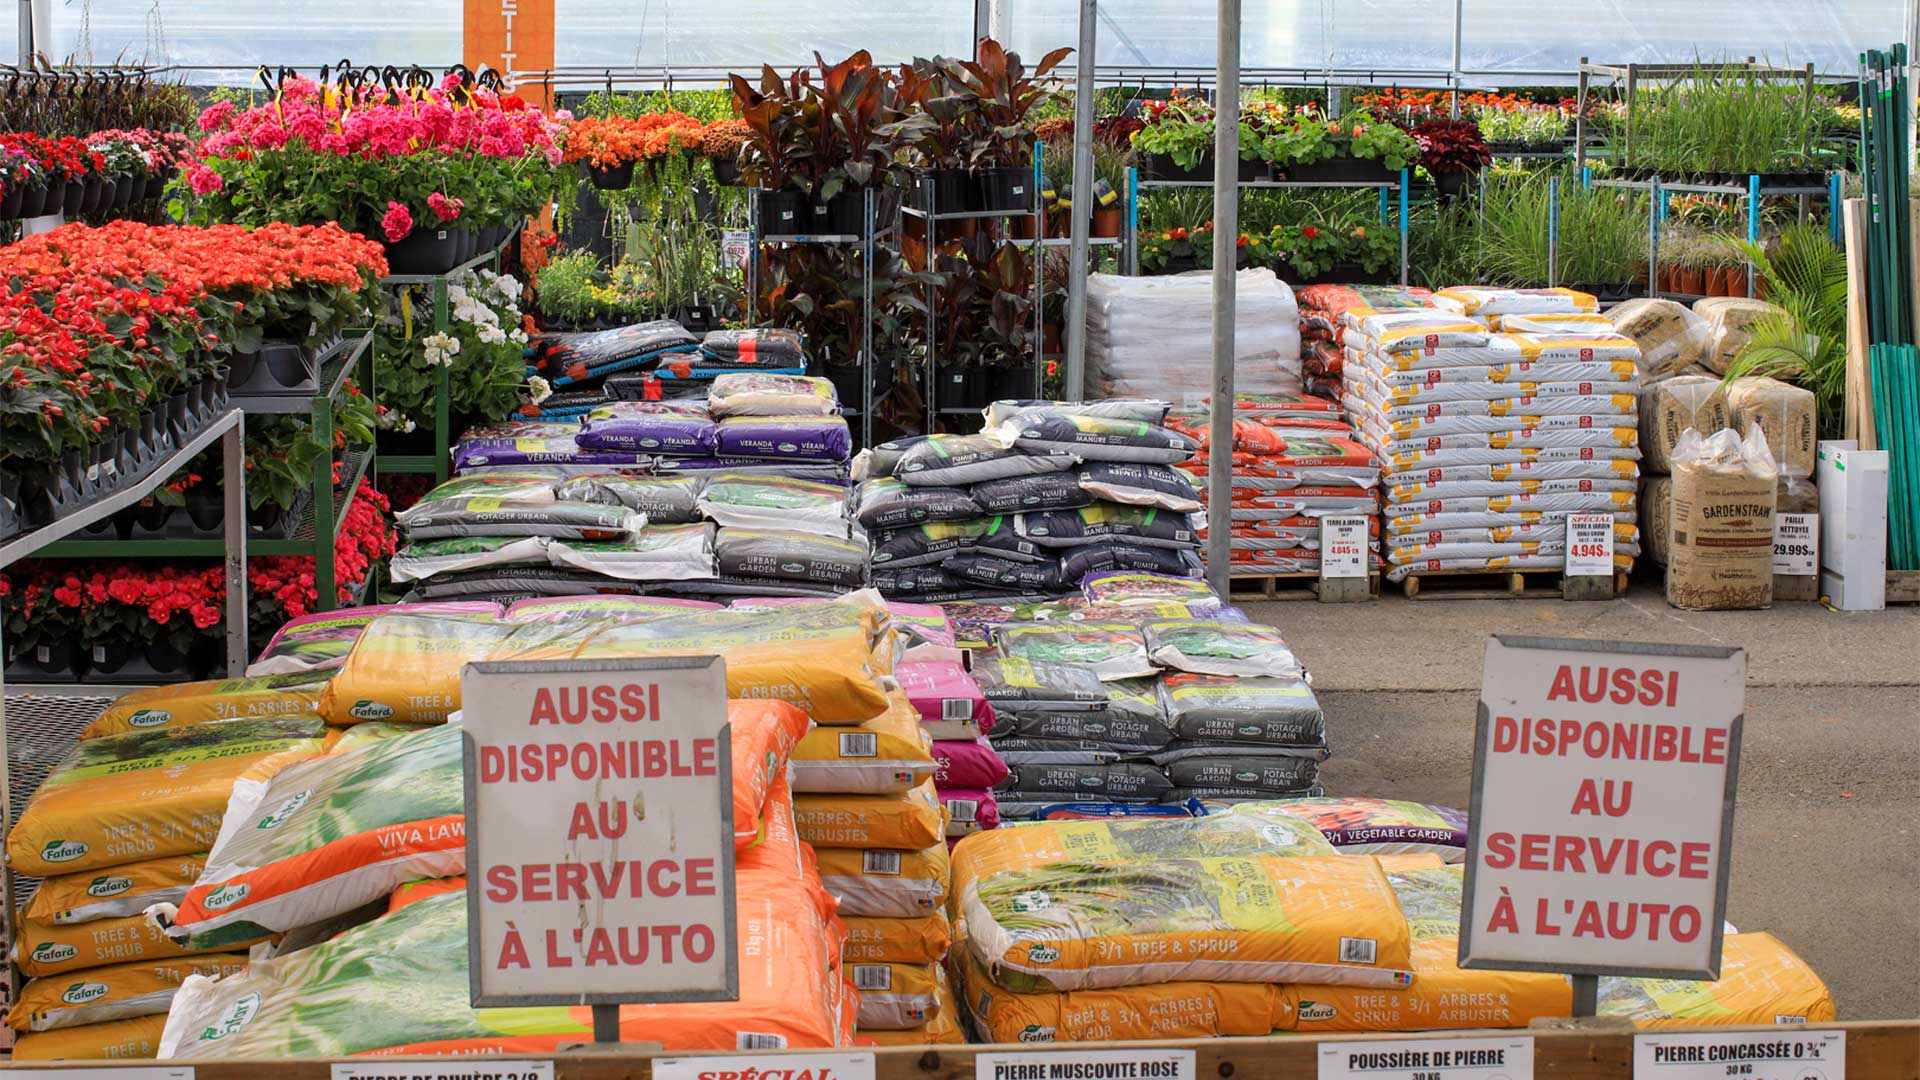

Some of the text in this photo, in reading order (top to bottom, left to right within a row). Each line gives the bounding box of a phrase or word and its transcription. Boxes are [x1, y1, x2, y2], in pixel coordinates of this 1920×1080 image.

[801, 442, 826, 450] VÉRAN
[637, 502, 674, 511] POTAGER
[1703, 504, 1771, 519] GARDENSTRAW
[476, 512, 516, 521] POTAGER
[739, 564, 776, 573] GARDEN
[748, 556, 777, 566] URBAN
[811, 562, 850, 571] POTAGER
[810, 570, 842, 579] URBAIN
[740, 684, 796, 699] ARBRES
[1546, 664, 1680, 708] AUSSI
[216, 702, 238, 718] 3/1
[248, 700, 300, 714] ARBRES
[408, 695, 454, 708] TREE &
[529, 684, 660, 726] AUSSI
[133, 712, 168, 725] Fafard
[355, 707, 390, 717] Fafard
[410, 711, 448, 721] SHRU
[1050, 716, 1080, 726] URBAN
[1110, 722, 1150, 732] POTAGER
[1206, 720, 1234, 728] URBAN
[1042, 724, 1080, 734] GARDEN
[1110, 730, 1141, 738] URBAIN
[1198, 728, 1234, 736] GARDEN
[1266, 732, 1296, 740] URBAIN
[1492, 716, 1728, 765] DISPONIBLE
[480, 738, 716, 784] DISPONIBLE
[1047, 770, 1076, 780] URBAN
[1194, 774, 1231, 782] GARDEN
[1202, 766, 1232, 776] URBAN
[1038, 778, 1076, 786] GARDEN
[1108, 775, 1146, 784] POTAGER
[1107, 783, 1137, 792] URBAIN
[1570, 778, 1633, 818] AU
[568, 800, 628, 840] AU
[103, 823, 152, 841] TREE &
[160, 822, 184, 840] 3/1
[378, 822, 465, 849] VIVA LAW
[1325, 828, 1452, 842] 3/1 VEGETABLE GARDEN
[46, 845, 85, 860] Fafard
[106, 839, 156, 857] SHRUB
[1484, 832, 1712, 880] SERVICE
[92, 878, 130, 895] Fafard
[486, 858, 716, 903] SERVICE
[1486, 886, 1702, 944] À L'AUTO
[92, 928, 140, 944] TREE &
[96, 942, 144, 960] SHRUB
[497, 920, 531, 970] À
[546, 924, 716, 968] L'AUTO
[1098, 938, 1239, 960] 3/1 TREE & SHRUB
[37, 946, 76, 961] Fafard
[154, 966, 180, 982] 3/1
[68, 984, 106, 1001] Fafard
[1438, 993, 1510, 1007] ARBRES &
[1148, 999, 1203, 1016] ARBRES
[1354, 995, 1400, 1008] TREE &
[1408, 998, 1432, 1015] 3/1
[1100, 1009, 1110, 1022] &
[1119, 1009, 1142, 1026] 3/1
[1354, 1011, 1400, 1023] SHRUB
[1438, 1008, 1510, 1022] ARBUSTES
[102, 1042, 151, 1059] TREE &
[1654, 1046, 1704, 1062] PIERRE
[1708, 1040, 1791, 1061] CONCASSÉE
[1349, 1049, 1504, 1069] POUSSIÈRE DE PIERRE
[994, 1061, 1179, 1080] PIERRE MUSCOVITE ROSE
[1726, 1064, 1752, 1076] 30 KG
